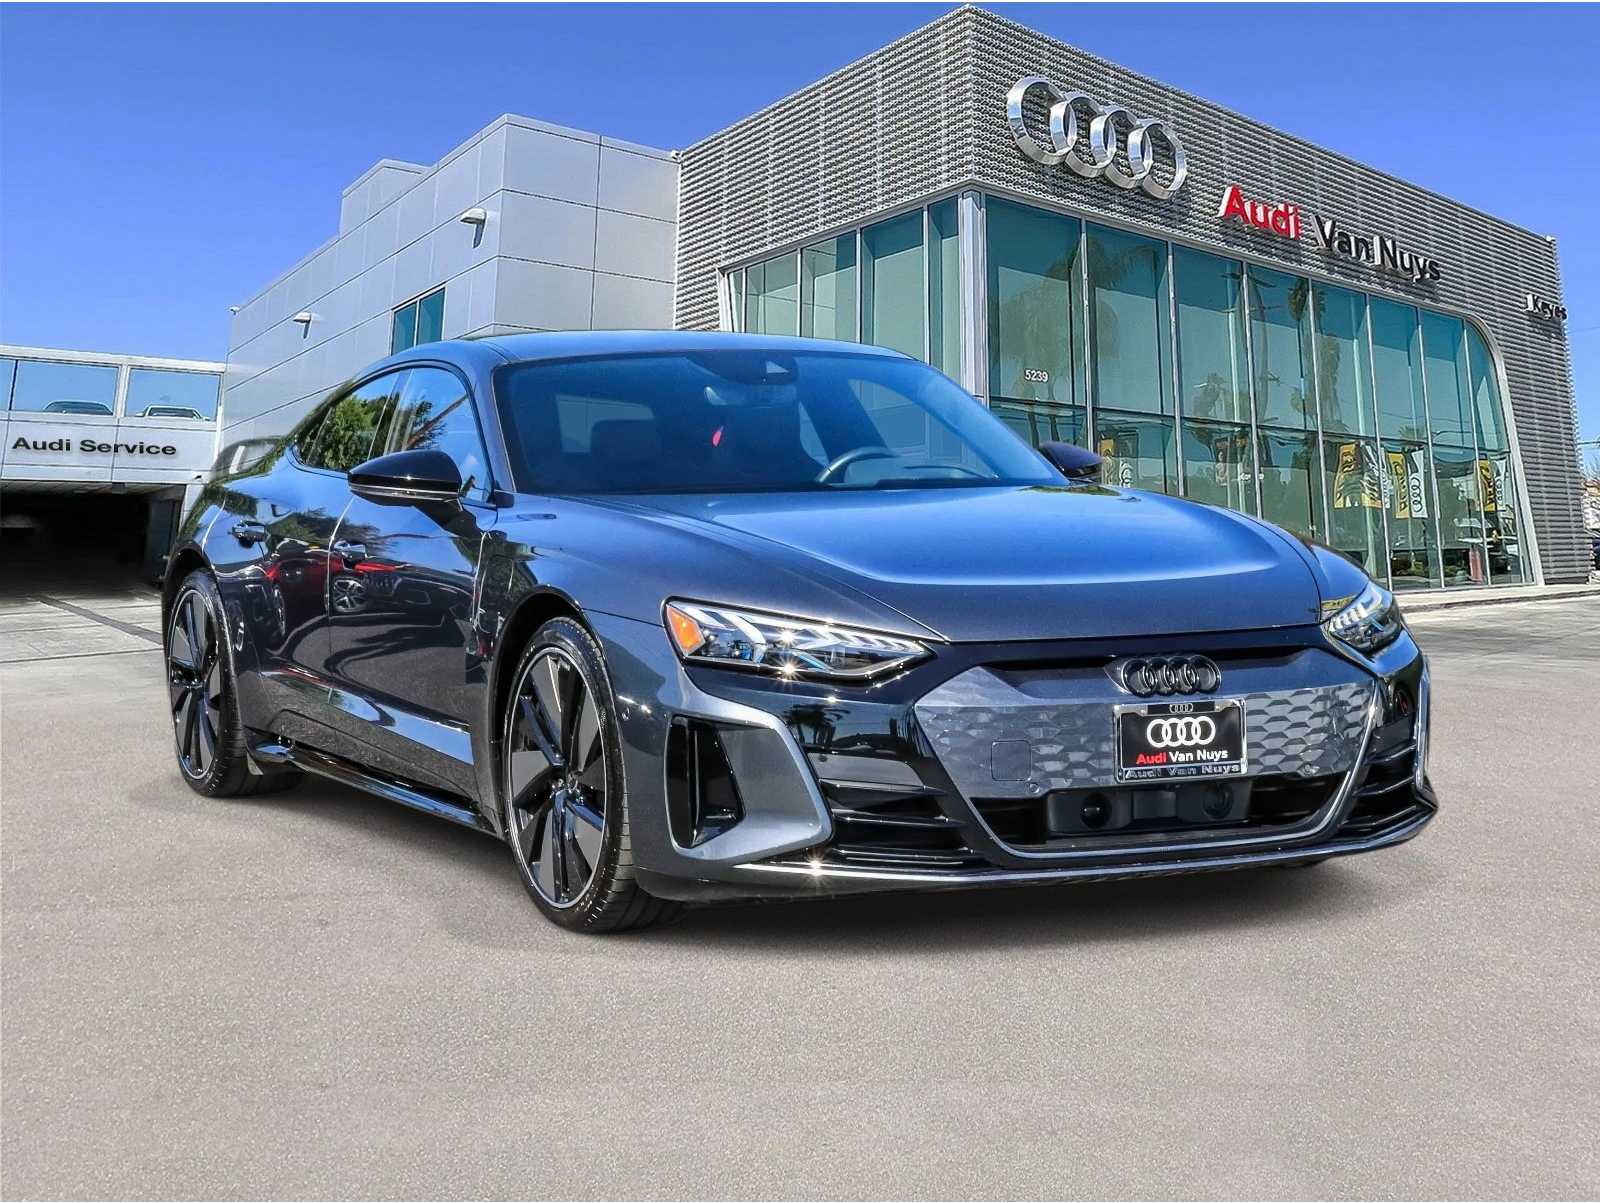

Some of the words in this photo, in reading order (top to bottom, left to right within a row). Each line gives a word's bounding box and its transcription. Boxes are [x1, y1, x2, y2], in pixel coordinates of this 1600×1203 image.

[1216, 184, 1301, 241] Audi
[1311, 214, 1372, 261] Van
[1374, 235, 1440, 282] Nuys
[1025, 369, 1048, 382] 5239
[12, 436, 71, 452] Audi
[79, 439, 177, 456] Service
[1136, 752, 1167, 765] Audi
[1168, 750, 1194, 763] Van
[1196, 748, 1229, 762] Nuys
[1125, 765, 1162, 779] Audi
[1168, 765, 1197, 776] Van
[1201, 763, 1240, 775] Nuys
